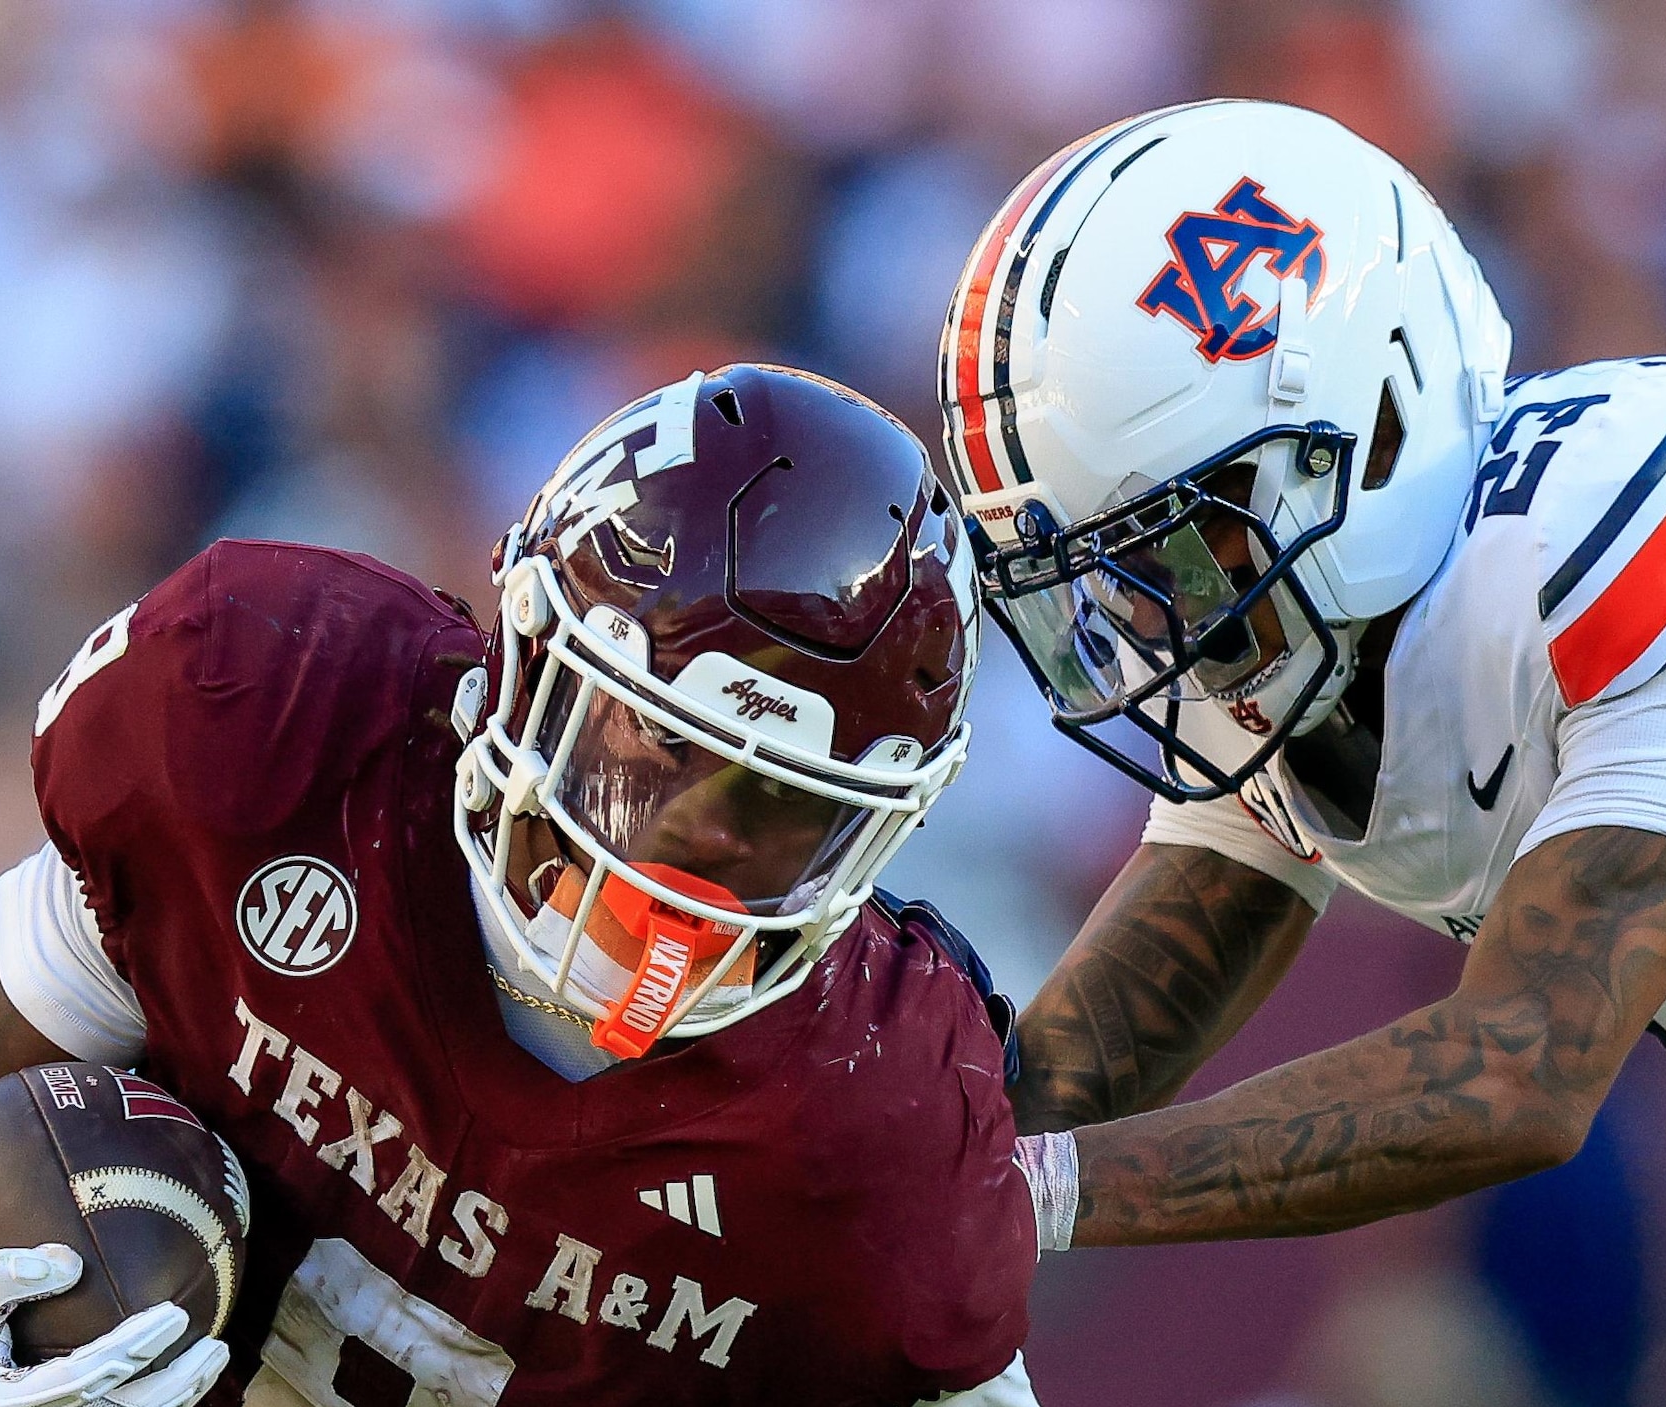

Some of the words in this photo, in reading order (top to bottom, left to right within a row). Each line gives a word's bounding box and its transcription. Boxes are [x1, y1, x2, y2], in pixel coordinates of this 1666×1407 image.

[976, 505, 1014, 522] TIGERS
[34, 600, 139, 737] 8
[722, 679, 797, 722] Aggies
[245, 862, 355, 971] SEC
[621, 933, 690, 1033] NXTRND
[227, 997, 509, 1278] TEXAS
[526, 1233, 758, 1369] A&M
